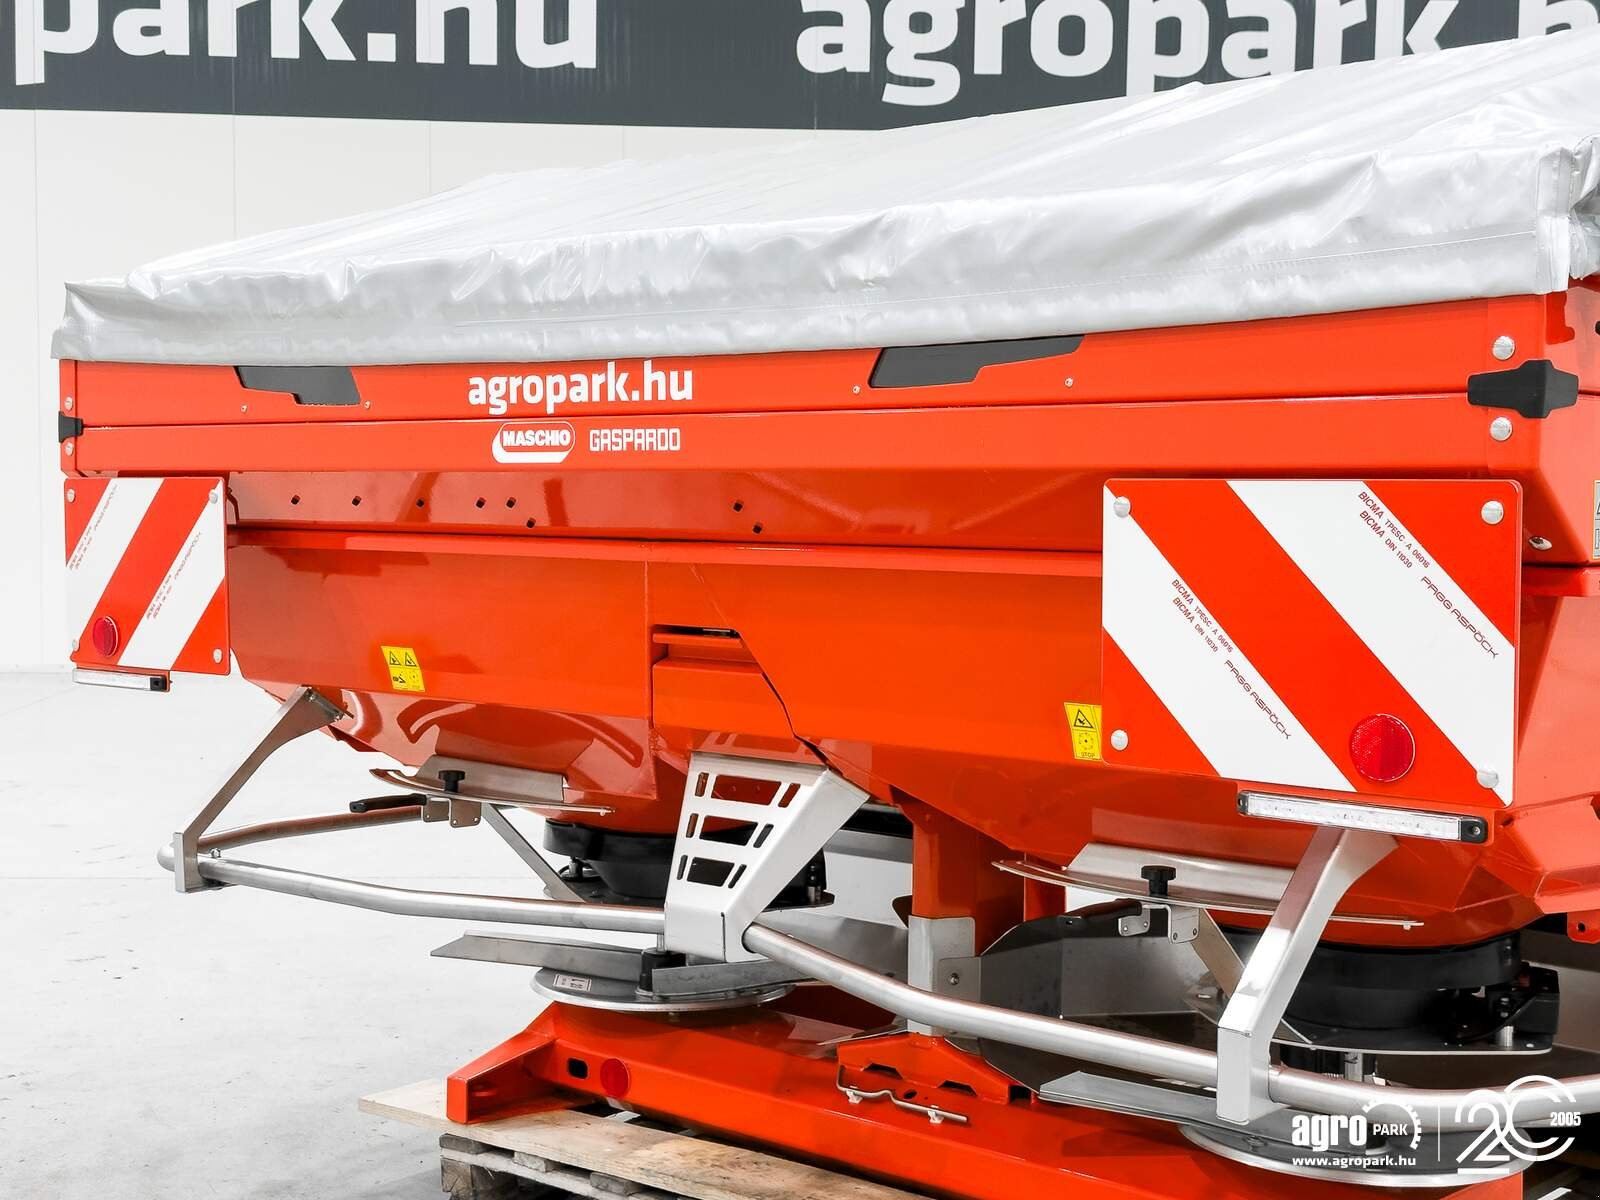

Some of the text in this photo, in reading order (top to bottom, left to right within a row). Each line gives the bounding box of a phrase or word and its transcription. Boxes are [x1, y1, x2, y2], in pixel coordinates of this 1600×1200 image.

[468, 360, 693, 415] agropark.hu
[502, 428, 681, 452] MASCHIO GASPARDO
[1358, 491, 1384, 519] BICMA
[1384, 519, 1406, 542] TPESC
[1359, 510, 1413, 569] BICMA DIN 11030
[1171, 579, 1194, 605] BICMA
[1172, 597, 1195, 624] BICMA
